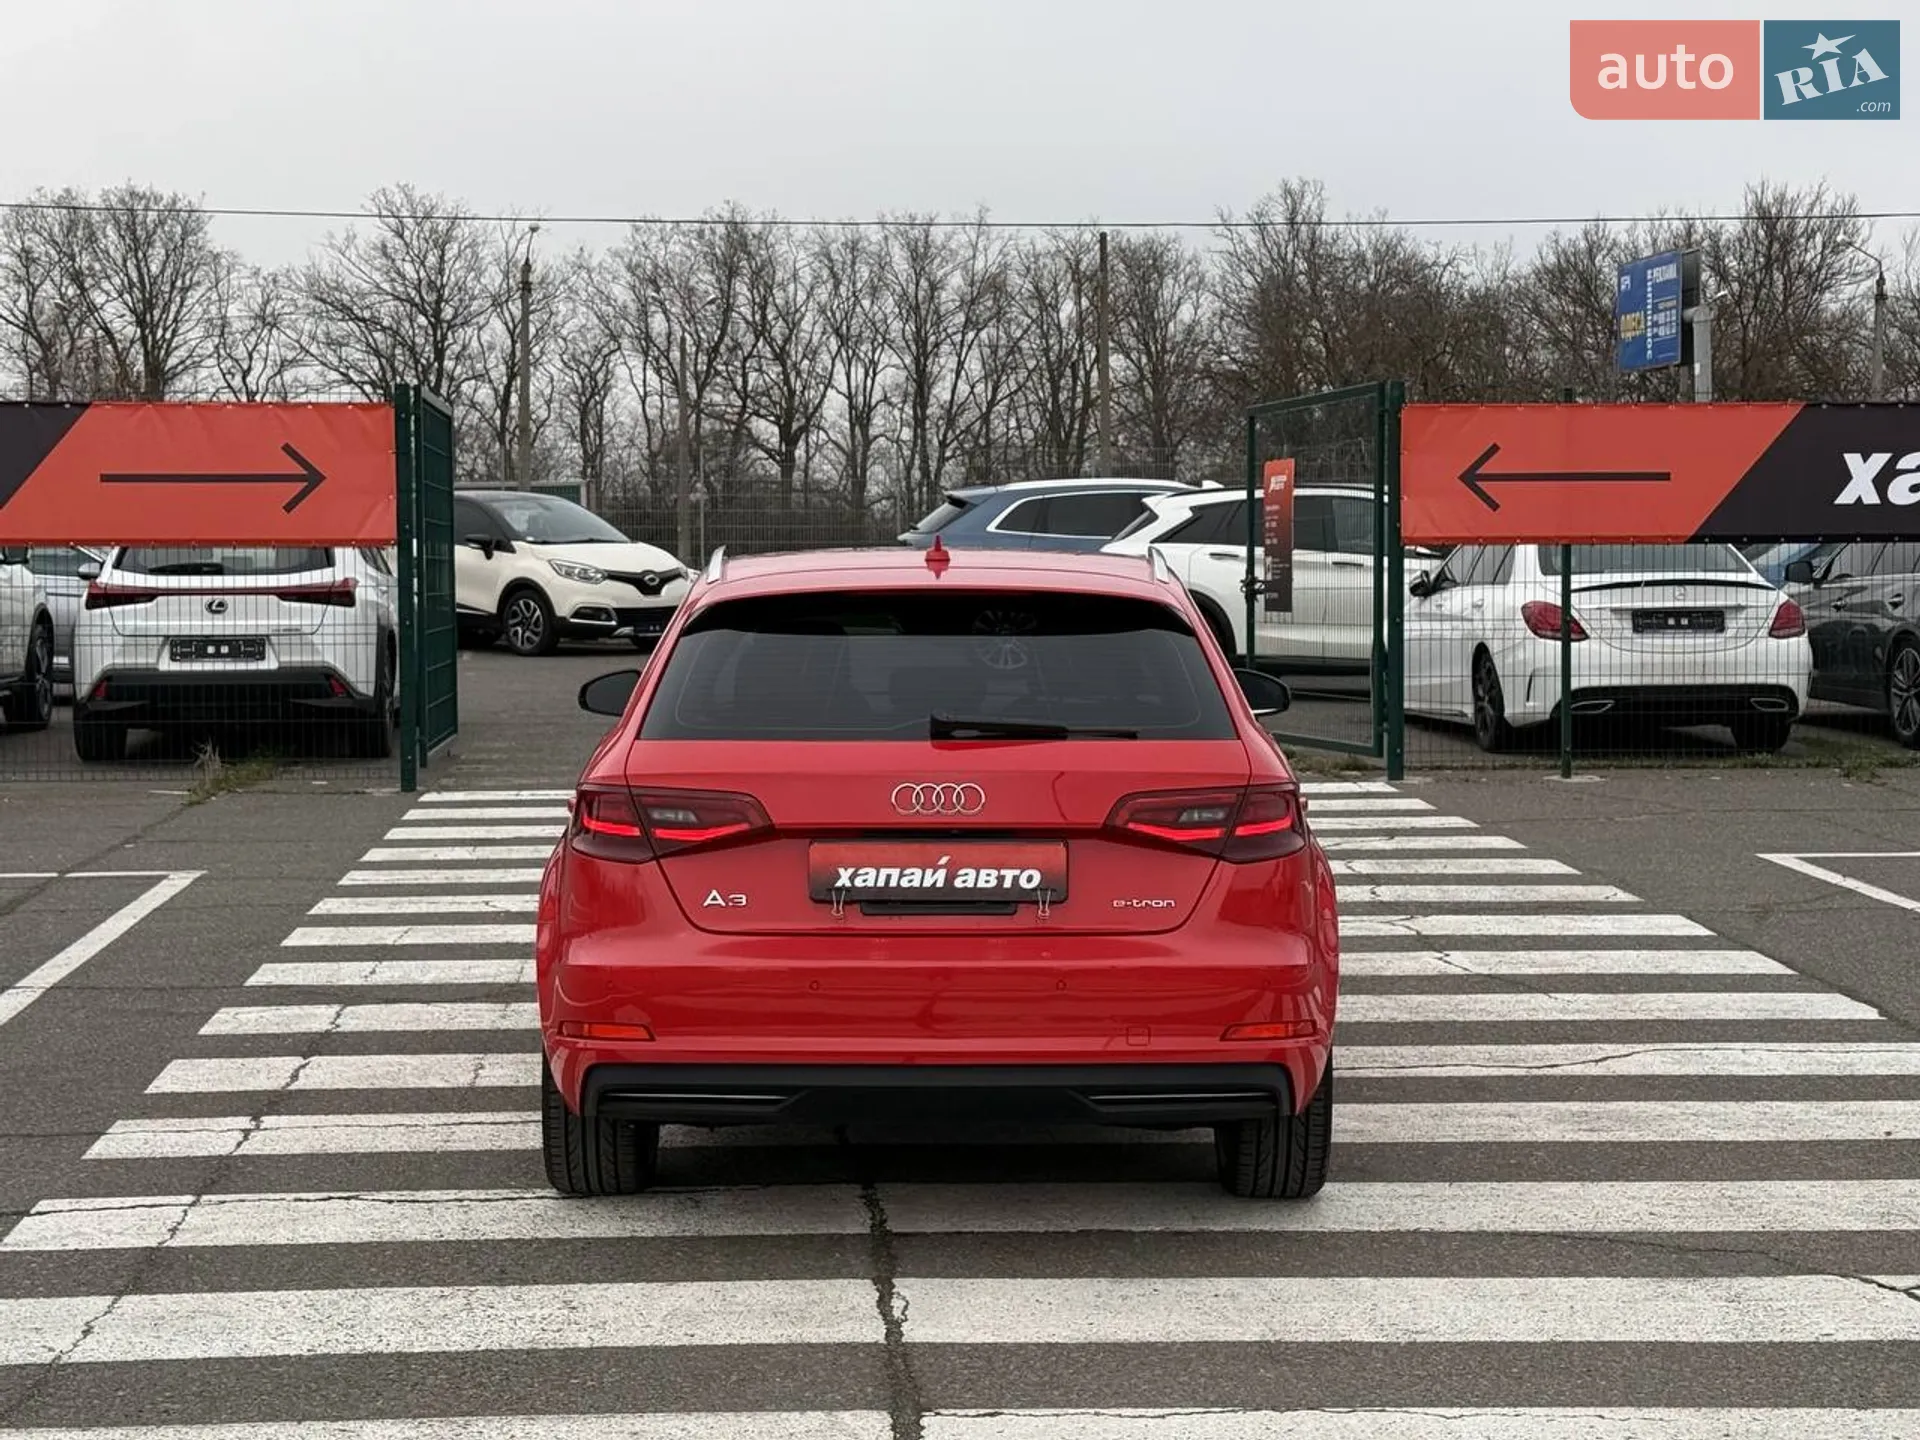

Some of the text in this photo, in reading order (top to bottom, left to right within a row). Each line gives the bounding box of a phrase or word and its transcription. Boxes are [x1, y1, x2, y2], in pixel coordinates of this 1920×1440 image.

[834, 855, 1041, 889] хапай авто
[703, 889, 747, 907] A3
[1112, 899, 1176, 908] e-tron
